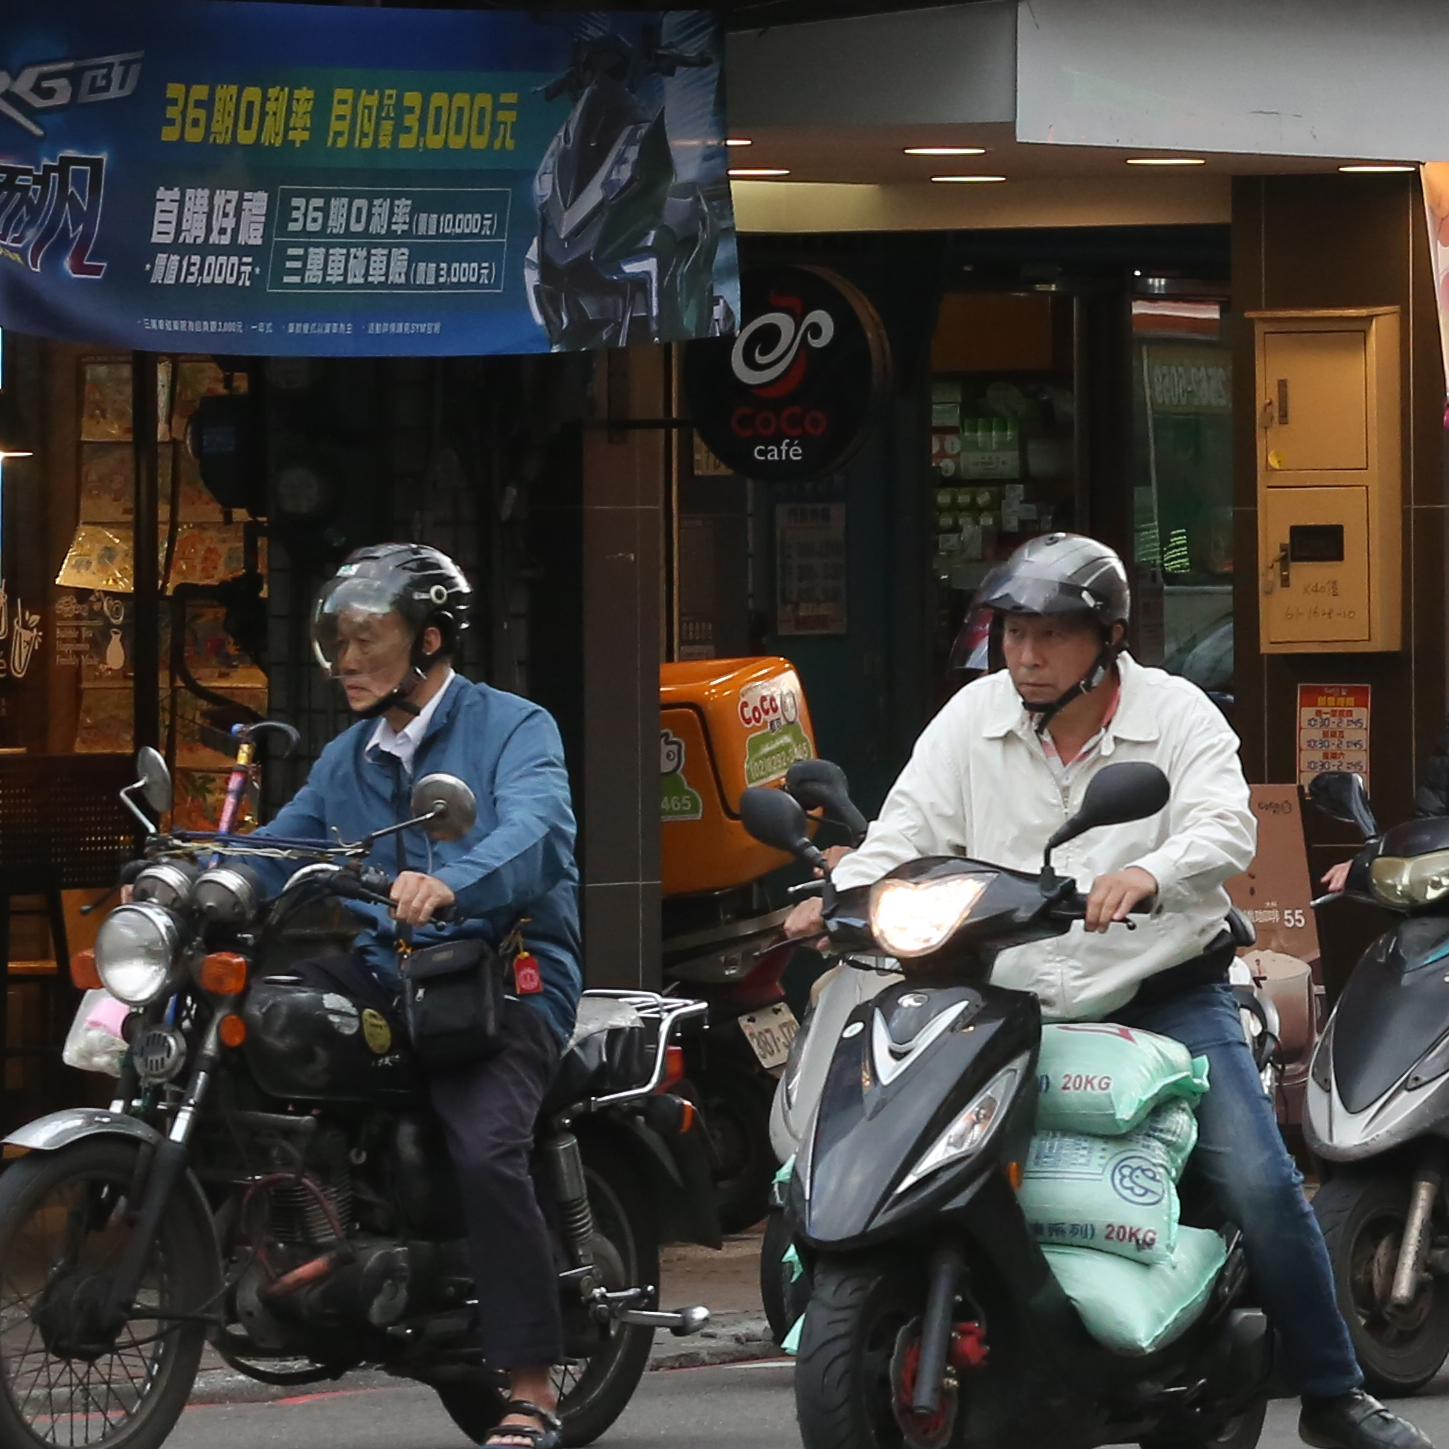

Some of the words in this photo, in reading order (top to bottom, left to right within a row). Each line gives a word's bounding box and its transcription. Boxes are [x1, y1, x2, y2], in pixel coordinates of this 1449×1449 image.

[150, 186, 270, 246] 首購好禮
[731, 406, 828, 438] CoCo
[753, 438, 803, 461] café
[739, 694, 780, 726] CoCo
[1283, 908, 1306, 928] 55
[1061, 1073, 1113, 1092] 20KG
[1104, 1223, 1158, 1248] 20KG
